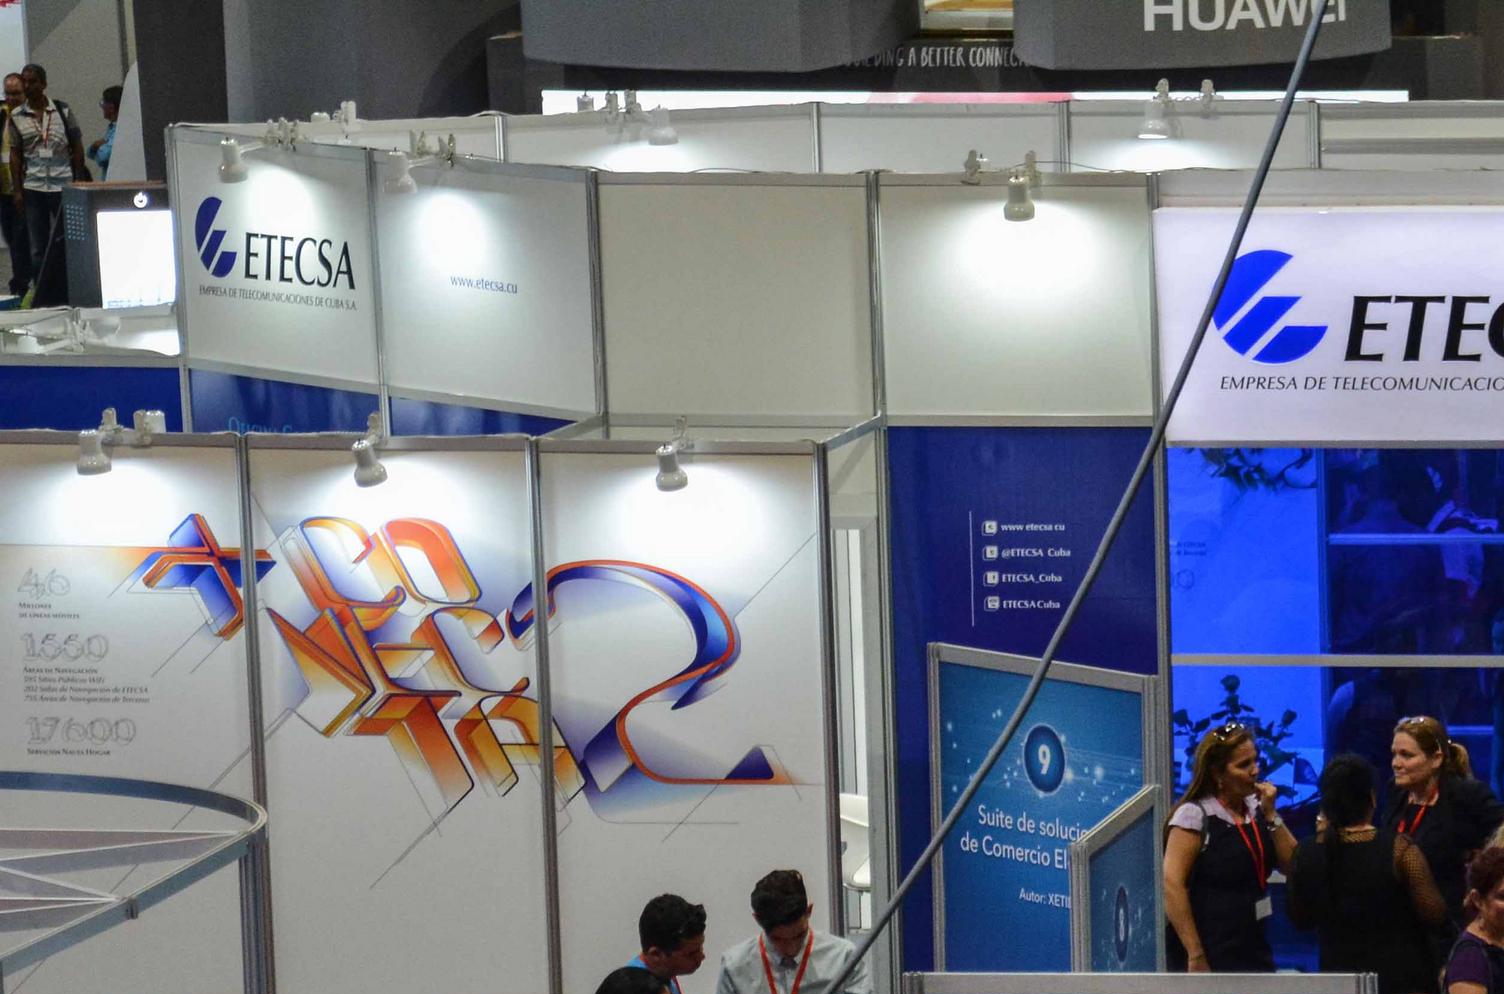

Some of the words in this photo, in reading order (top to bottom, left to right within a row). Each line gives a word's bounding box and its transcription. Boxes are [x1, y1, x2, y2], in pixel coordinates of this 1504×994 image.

[1143, 0, 1347, 32] HUAWI
[907, 46, 917, 67] A
[920, 46, 966, 67] BETTER
[244, 231, 356, 290] ETECSA
[199, 284, 228, 298] EMPRESA
[228, 288, 238, 299] DE
[238, 288, 314, 307] TELECOMUNICACIONES
[314, 295, 324, 307] DE
[324, 297, 345, 309] CUBA
[450, 275, 519, 295] www.etecsa.cu
[1219, 375, 1299, 392] EMPRESA
[1303, 375, 1328, 391] DE
[1037, 743, 1051, 776] 9
[977, 804, 1014, 831] Suite
[1016, 812, 1036, 835] de
[1039, 815, 1090, 841] solucio
[960, 832, 979, 854] de
[981, 835, 1051, 867] Comercio
[1054, 847, 1069, 870] El
[1019, 886, 1046, 906] Autor:
[1047, 892, 1071, 909] XETI
